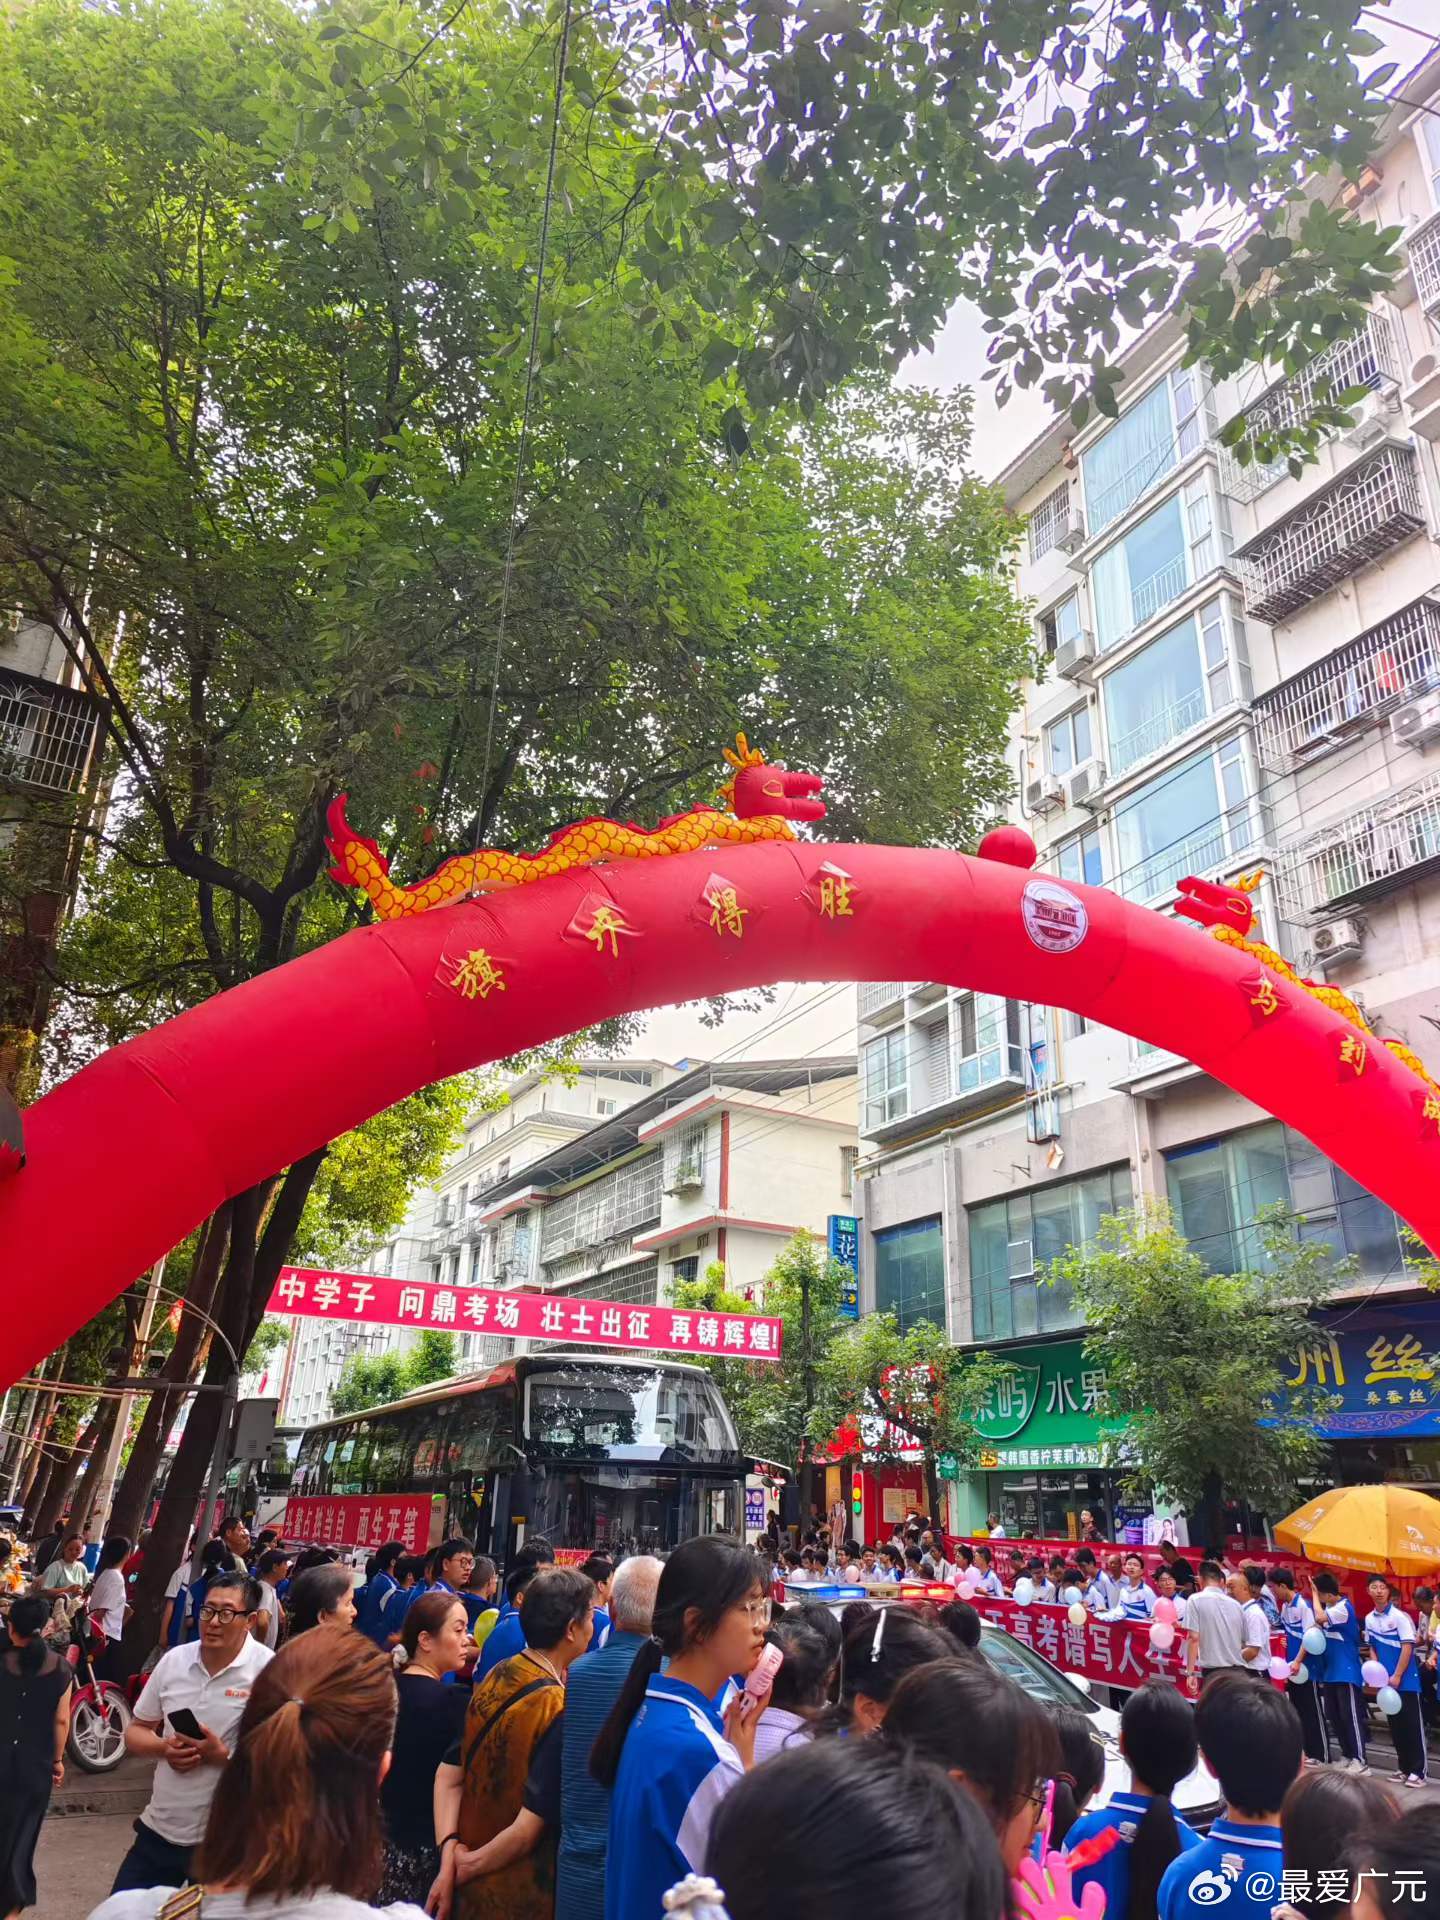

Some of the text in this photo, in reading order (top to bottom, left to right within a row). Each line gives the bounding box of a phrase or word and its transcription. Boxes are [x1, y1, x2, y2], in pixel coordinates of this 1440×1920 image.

[278, 1274, 376, 1313] 中学子
[399, 1287, 519, 1326] 问鼎考场
[541, 1302, 651, 1341] 壮士出征
[1367, 1389, 1426, 1405] 桑蚕丝
